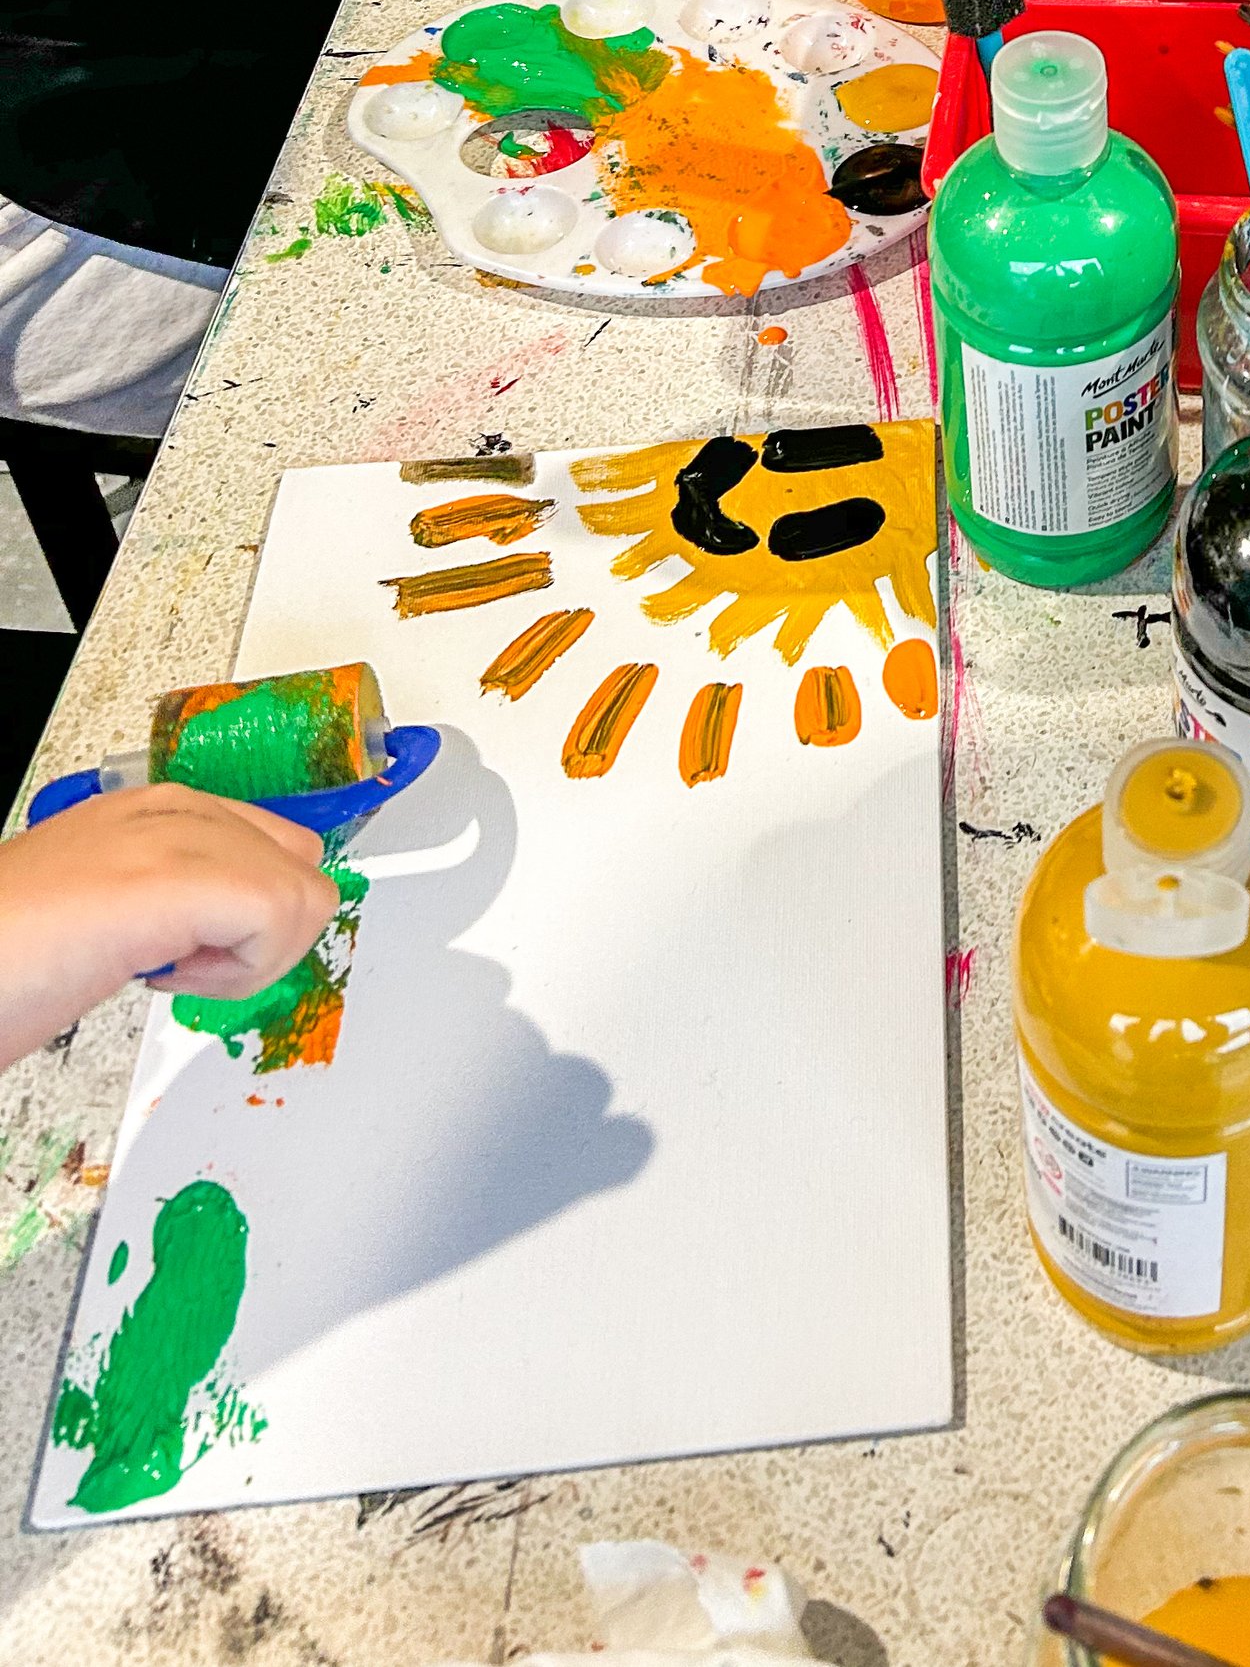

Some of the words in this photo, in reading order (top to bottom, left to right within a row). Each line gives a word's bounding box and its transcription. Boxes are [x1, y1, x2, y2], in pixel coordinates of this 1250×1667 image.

[1081, 364, 1125, 397] Mont
[1123, 338, 1162, 378] Marte
[1085, 362, 1169, 431] POSTER
[1086, 399, 1156, 453] PAINT
